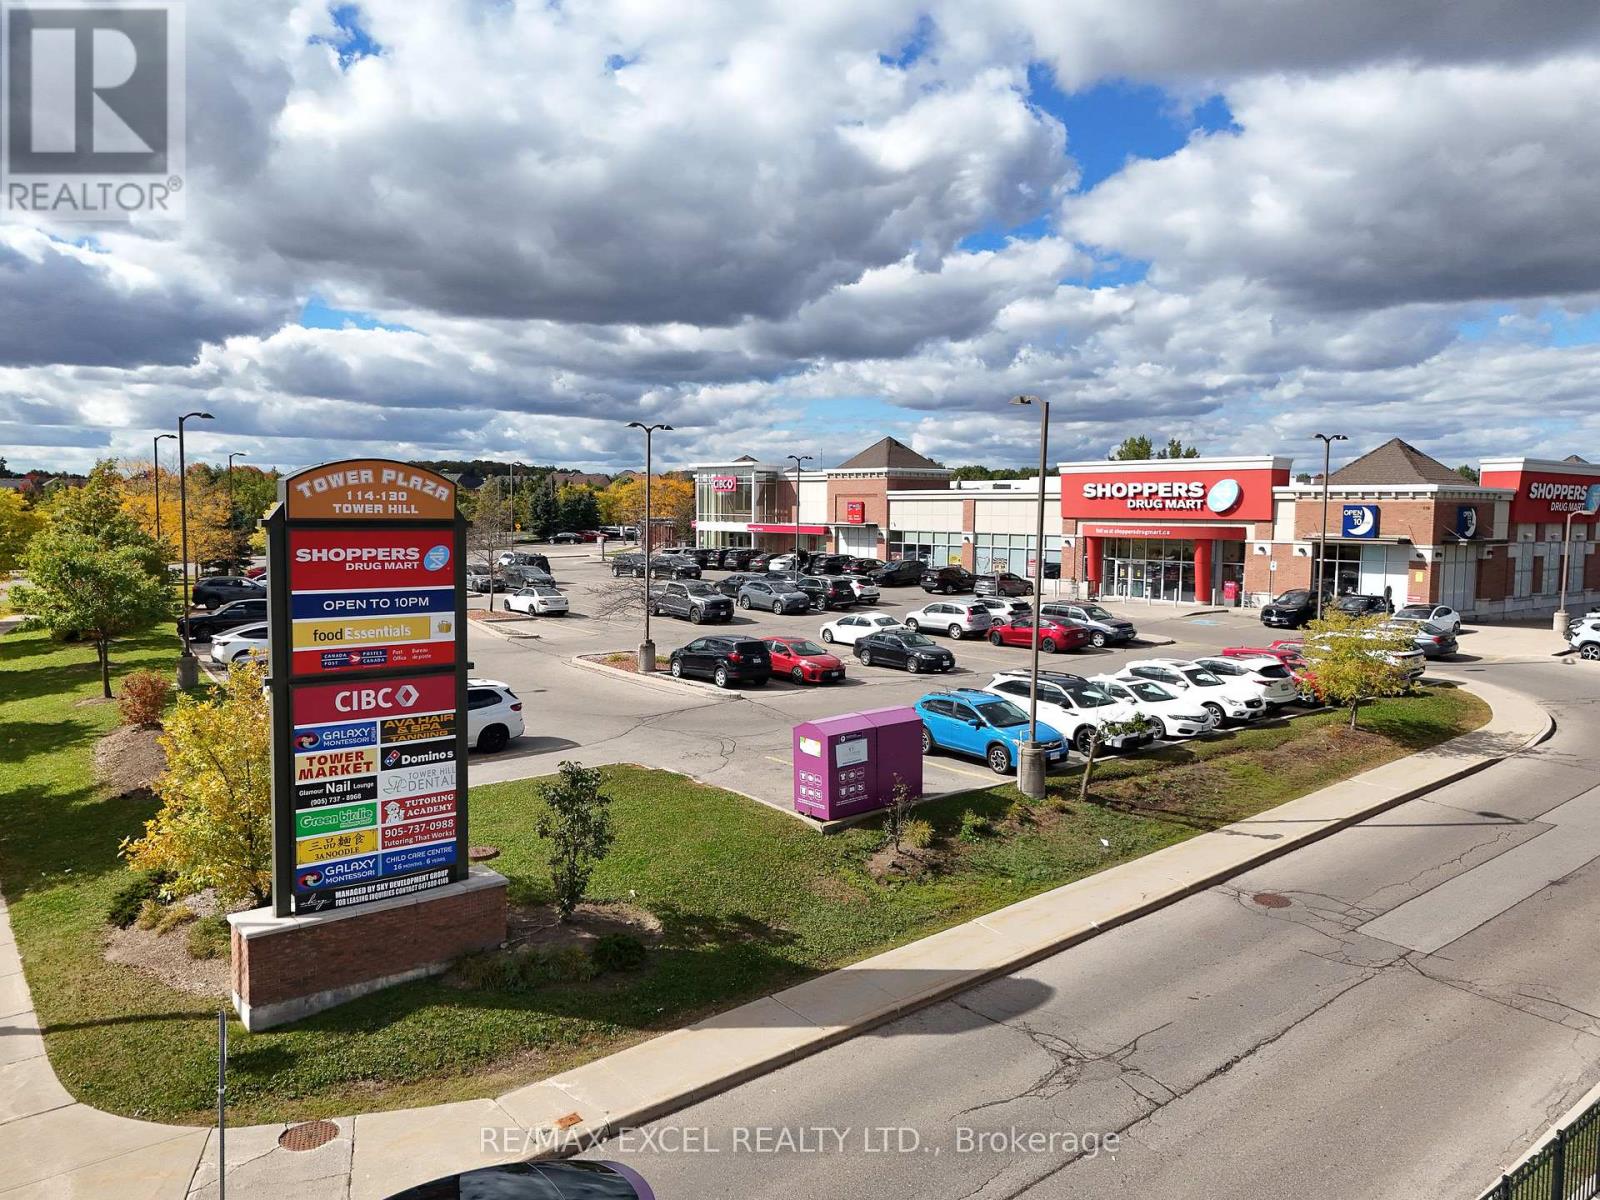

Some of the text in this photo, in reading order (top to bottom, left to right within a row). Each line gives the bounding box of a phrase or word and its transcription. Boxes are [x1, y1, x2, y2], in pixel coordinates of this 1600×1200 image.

[296, 468, 451, 502] TOWER PLAZA
[1081, 481, 1206, 499] SHOPPERS
[1529, 482, 1587, 500] SHOPPERS
[346, 490, 408, 502] 114-130
[333, 503, 419, 514] TOWER HILL
[1127, 498, 1204, 510] DRUG MART
[1550, 502, 1586, 512] DRUG MART
[1353, 518, 1362, 526] 10
[295, 547, 420, 563] SHOPPERS
[345, 560, 420, 572] DRUG MART
[323, 596, 430, 612] OPEN TO 10PM
[335, 687, 393, 712] CIBC
[384, 714, 454, 728] AVA HAIR
[397, 722, 441, 734] & SPA
[323, 728, 370, 741] GALAXY
[323, 736, 370, 747] MONTESSORI
[389, 730, 449, 742] TANNING
[306, 751, 365, 767] TOWER
[401, 750, 454, 764] Dominos
[298, 761, 374, 780] MARKET
[408, 766, 456, 780] TOWER HILL
[299, 788, 324, 797] Glamour
[326, 780, 351, 794] Nail
[353, 782, 374, 790] Lounge
[408, 774, 456, 792] DENTAL
[405, 794, 454, 808] TUTORING
[406, 803, 453, 817] ACADEMY
[300, 815, 339, 828] Green
[339, 808, 373, 822] birdie
[384, 818, 454, 838] 905-737-0988
[384, 829, 456, 847] Tutoring That Works!
[386, 846, 453, 864] CHILD CARE CENTRE
[325, 858, 376, 876] GALAXY
[325, 870, 376, 884] MONTESSORI
[335, 886, 366, 899] MANAGED
[376, 884, 389, 892] SKY
[389, 874, 429, 890] DEVELOPMENT
[430, 869, 449, 880] GROUP
[335, 898, 346, 907] FOR
